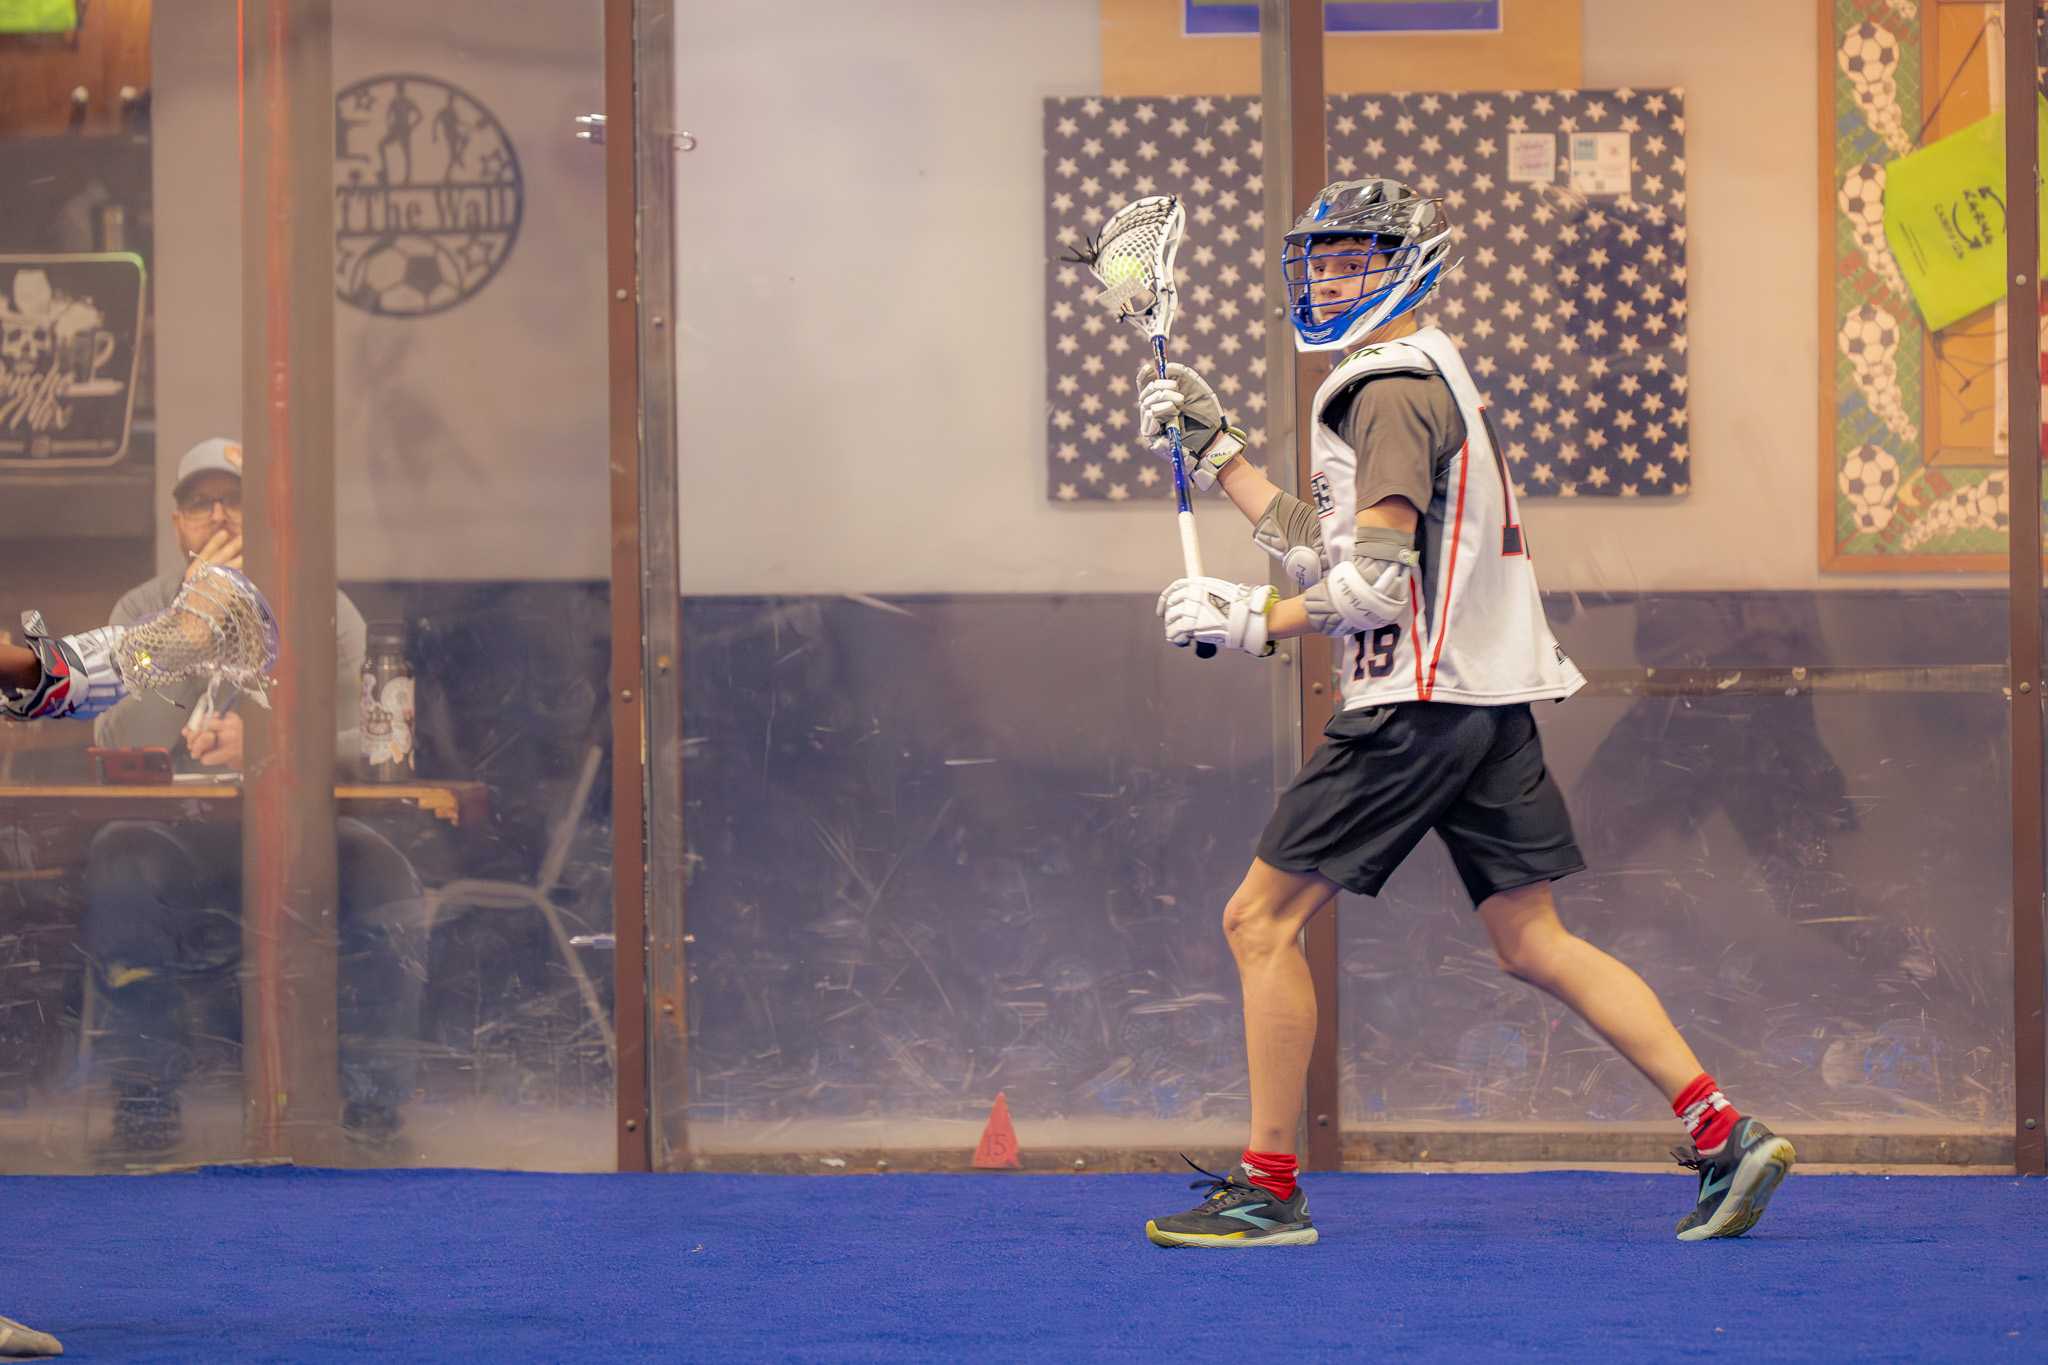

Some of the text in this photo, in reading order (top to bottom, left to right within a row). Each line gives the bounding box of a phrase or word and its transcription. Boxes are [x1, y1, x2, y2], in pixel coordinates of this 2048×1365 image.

[434, 184, 506, 231] Wall
[1353, 622, 1401, 681] 19
[986, 1133, 1007, 1156] 15
